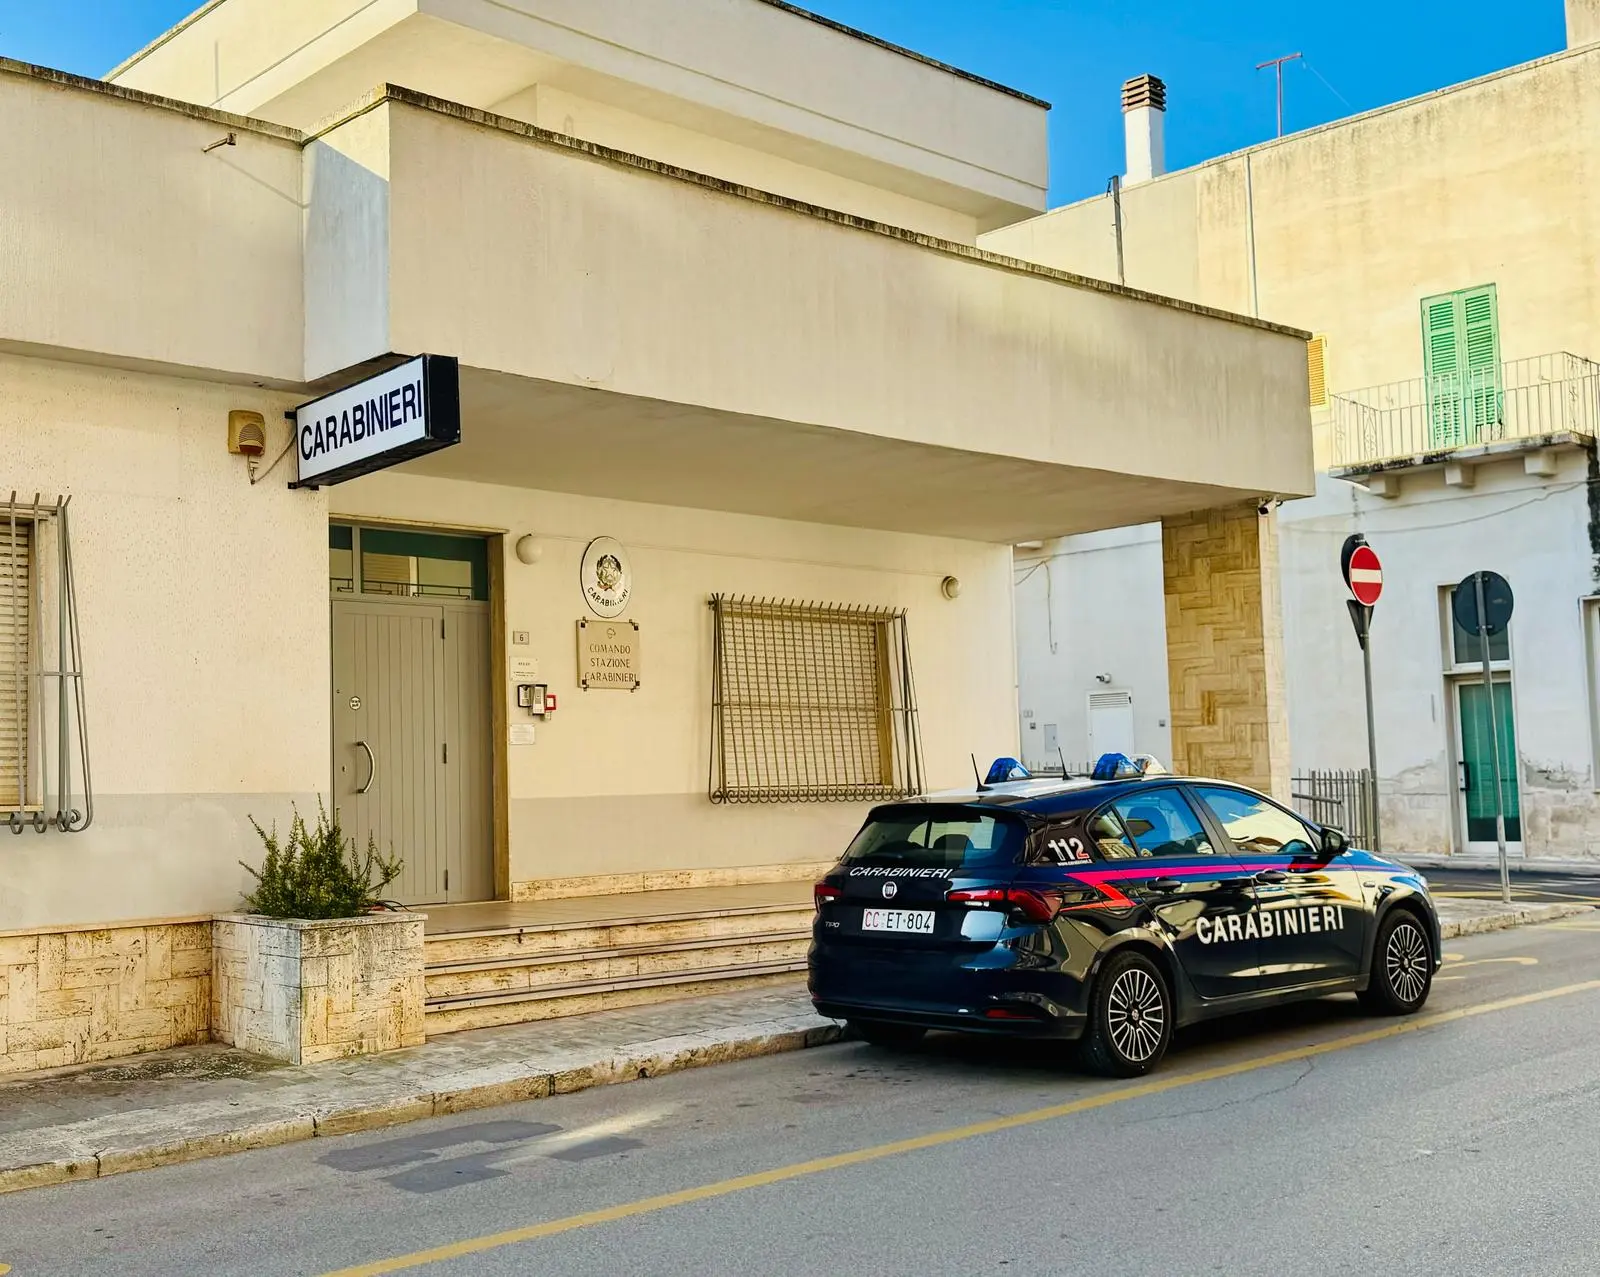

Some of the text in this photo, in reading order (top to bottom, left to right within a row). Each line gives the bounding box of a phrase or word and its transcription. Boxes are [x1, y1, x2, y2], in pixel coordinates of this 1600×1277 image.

[300, 380, 422, 461] CARABINIERI
[589, 643, 631, 654] COMANDO
[590, 657, 631, 668] STAZIONE
[584, 671, 637, 682] CARABINIERI
[1047, 837, 1090, 861] 112
[849, 866, 953, 879] CARABINIERI
[825, 920, 840, 928] TIPO
[865, 911, 932, 933] CC ET 804
[1196, 905, 1344, 945] CARABINIERI
